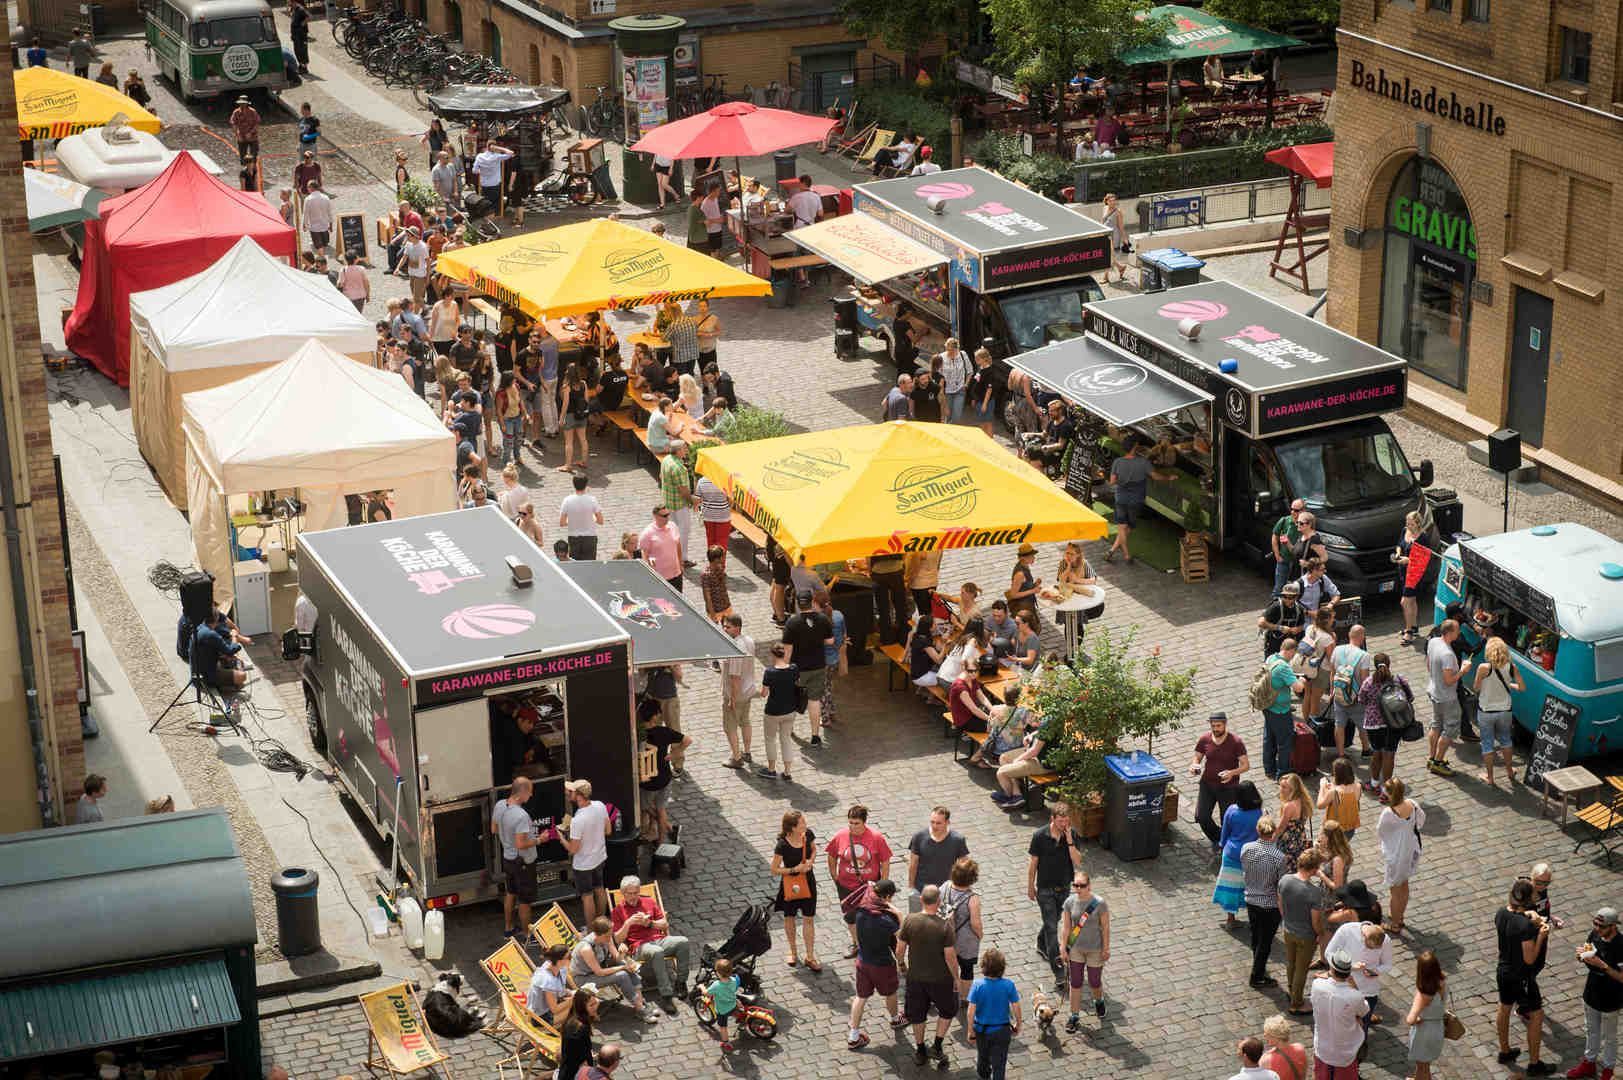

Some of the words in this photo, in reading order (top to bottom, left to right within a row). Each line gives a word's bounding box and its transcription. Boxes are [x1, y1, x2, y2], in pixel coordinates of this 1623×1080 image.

[1351, 60, 1506, 136] Bahnladehalle
[1395, 196, 1478, 260] GRAVIS
[991, 248, 1104, 277] KARAWANE-DER-KÖCHE.DE
[1093, 316, 1108, 338] WILD
[1110, 325, 1117, 342] &
[1119, 332, 1140, 354] WIESE
[1267, 384, 1397, 419] KARAWANE-DER-KÖCHE.DE
[379, 536, 430, 573] KÖCHE
[417, 548, 451, 569] DER
[423, 530, 481, 577] KARAWANE
[329, 612, 383, 699] KARAWANE
[431, 651, 613, 694] KARAWANE-DER-KÖCHE.DE
[334, 666, 375, 745] KÖCHE
[349, 662, 373, 714] DER
